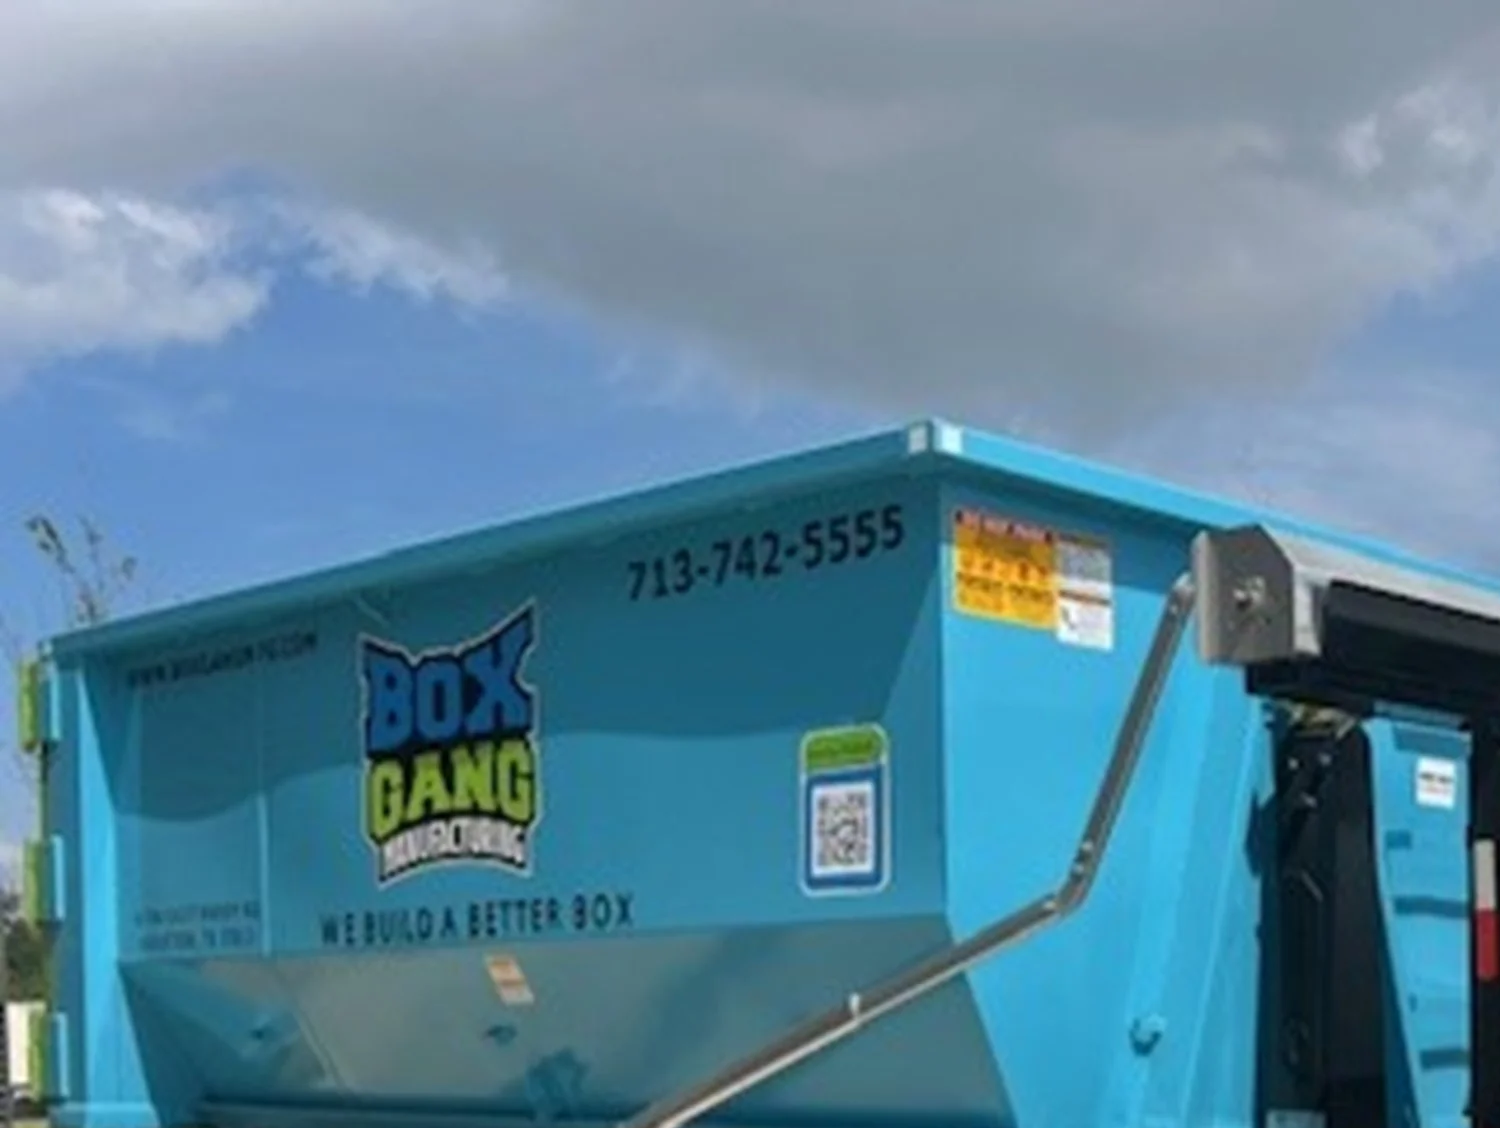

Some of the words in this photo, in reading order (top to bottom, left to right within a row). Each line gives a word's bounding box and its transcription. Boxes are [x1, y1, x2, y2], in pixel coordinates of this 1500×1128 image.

[628, 503, 905, 602] 713-742-5555
[368, 612, 530, 750] BOX
[370, 739, 534, 840] GANG
[320, 911, 356, 945] WE
[363, 906, 434, 945] BUILD
[440, 906, 457, 938] A
[467, 897, 562, 938] BETTER
[572, 892, 634, 931] BOX
